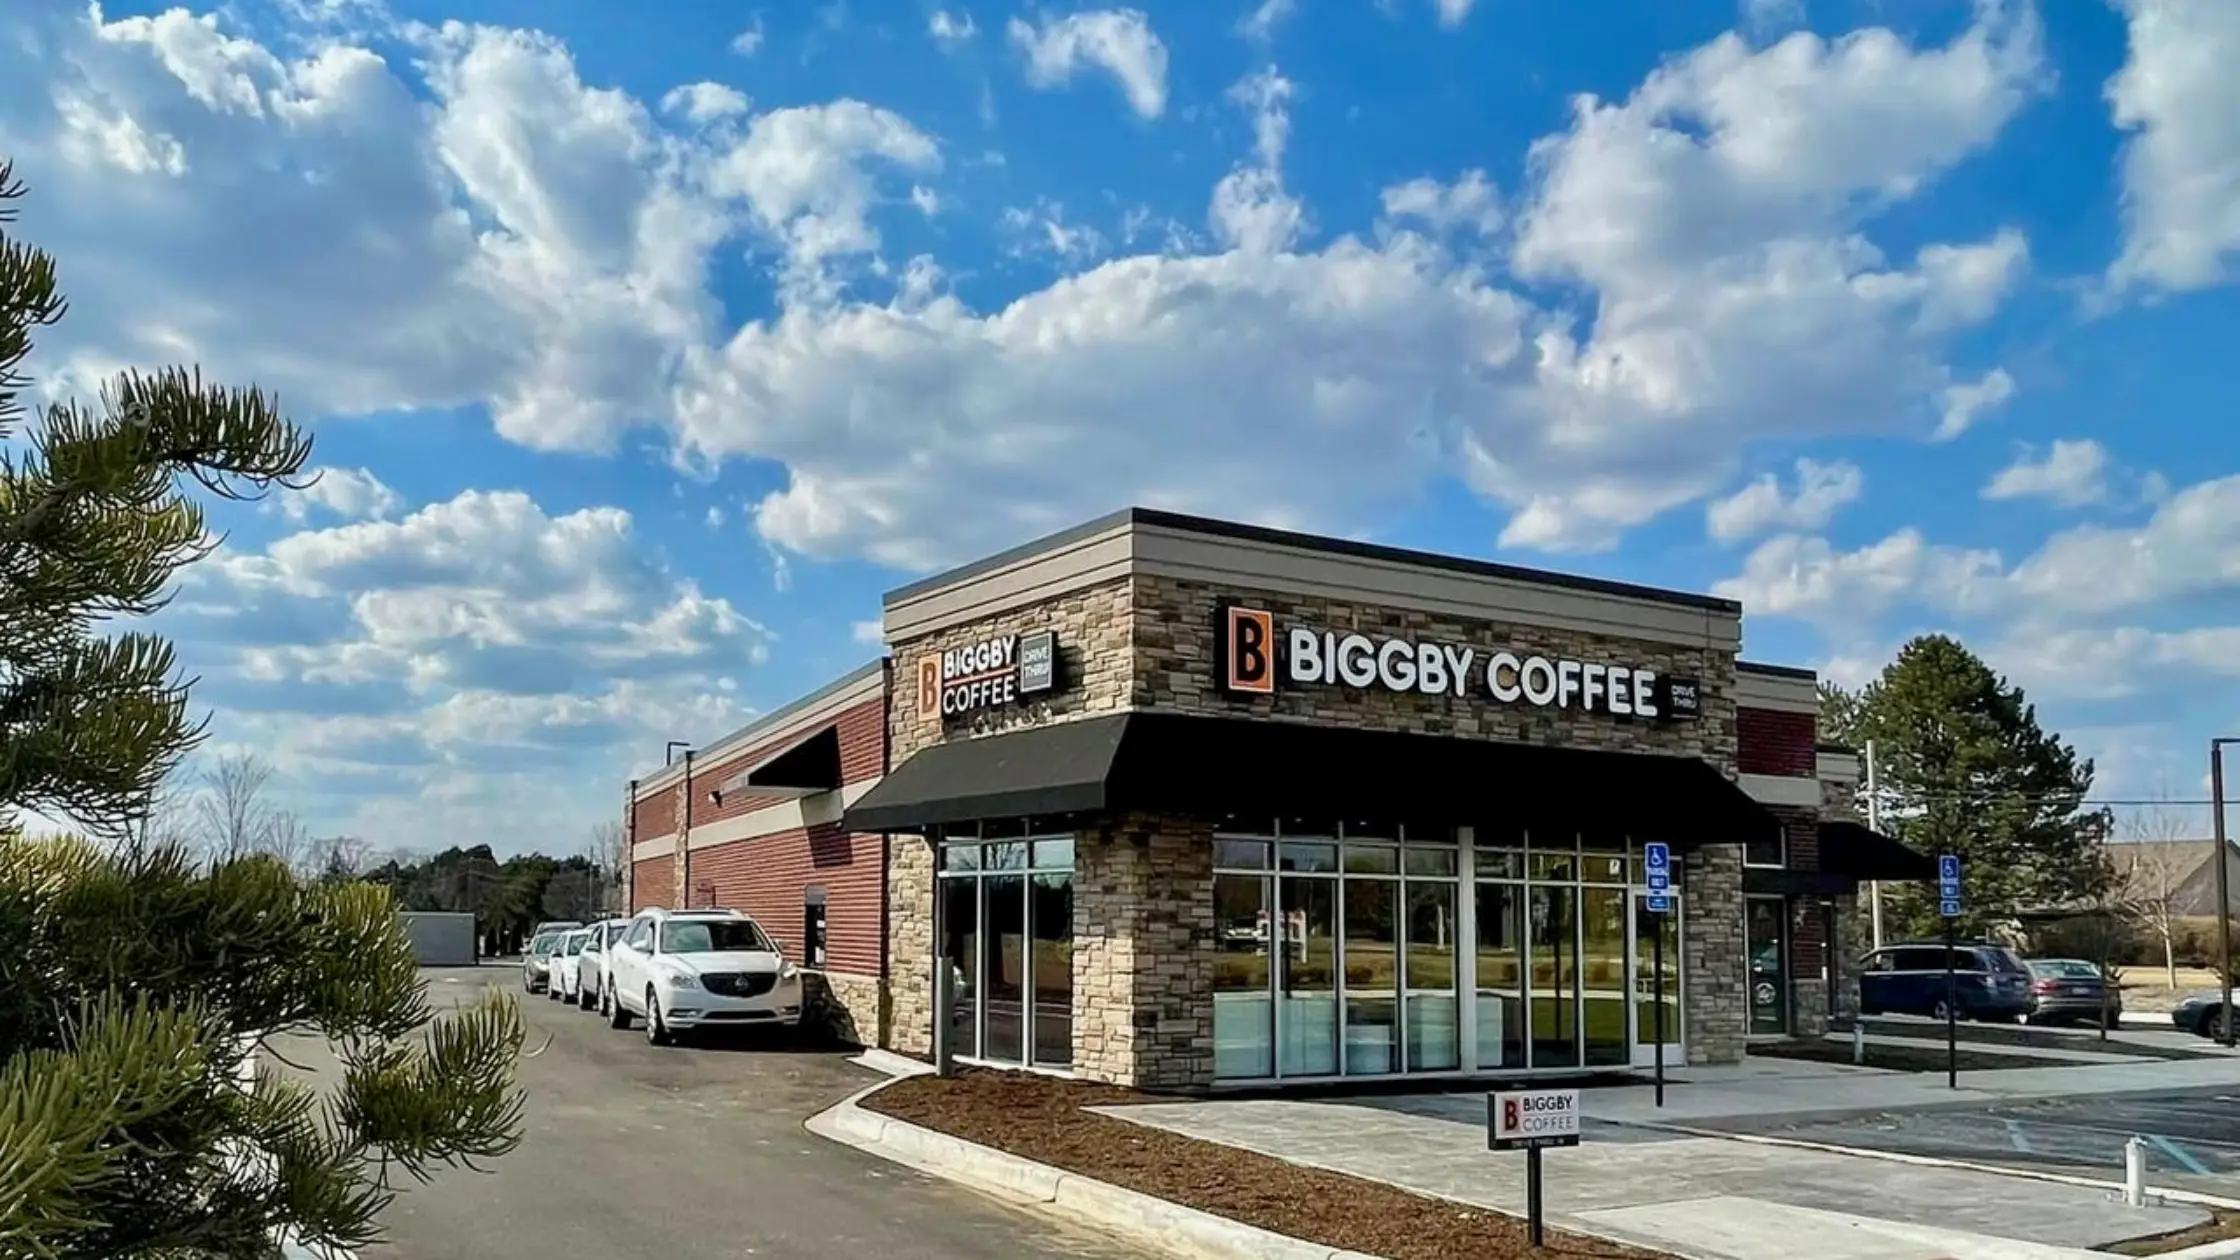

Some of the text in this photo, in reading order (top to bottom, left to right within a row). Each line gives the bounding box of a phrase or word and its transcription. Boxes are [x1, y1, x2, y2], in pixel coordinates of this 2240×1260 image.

[943, 634, 1016, 680] BIGGBY
[1236, 615, 1659, 718] B BIGGBY COFFEE
[921, 662, 937, 714] B
[942, 674, 1015, 715] COFFEE
[1504, 1099, 1519, 1131] B
[1522, 1115, 1573, 1132] COFFEE
[1523, 1094, 1573, 1112] BIGGBY
